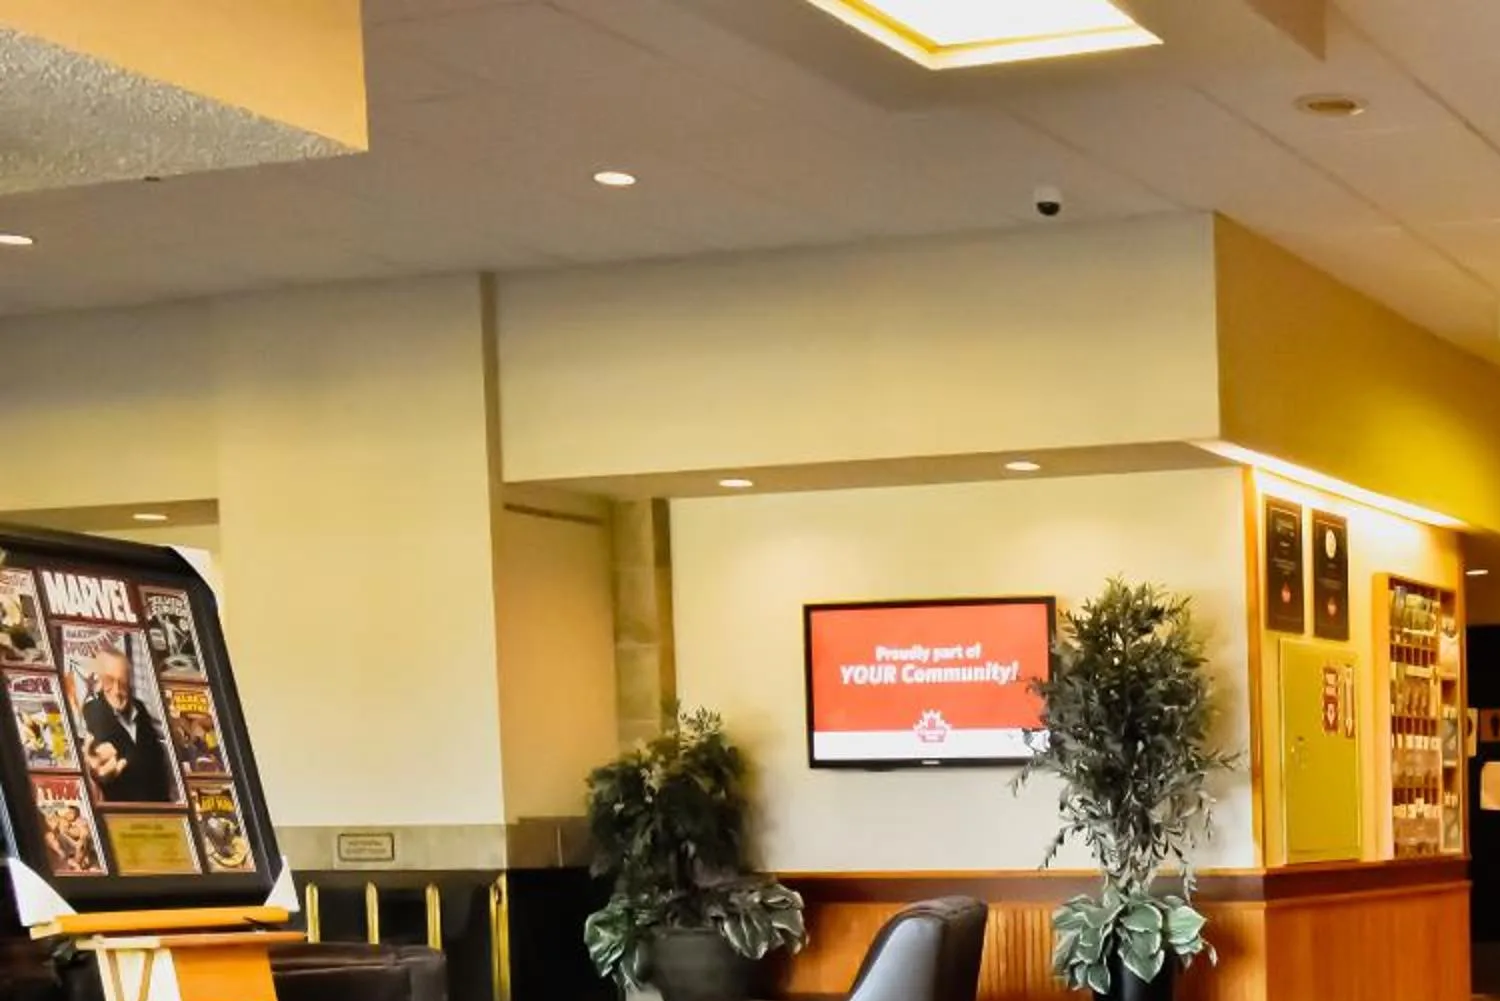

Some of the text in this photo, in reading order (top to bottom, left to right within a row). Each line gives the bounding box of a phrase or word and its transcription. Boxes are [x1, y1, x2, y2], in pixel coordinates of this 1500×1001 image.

[40, 570, 137, 623] MARVEL
[875, 642, 982, 663] Proudly part of
[840, 661, 1019, 685] YOUR Community!
